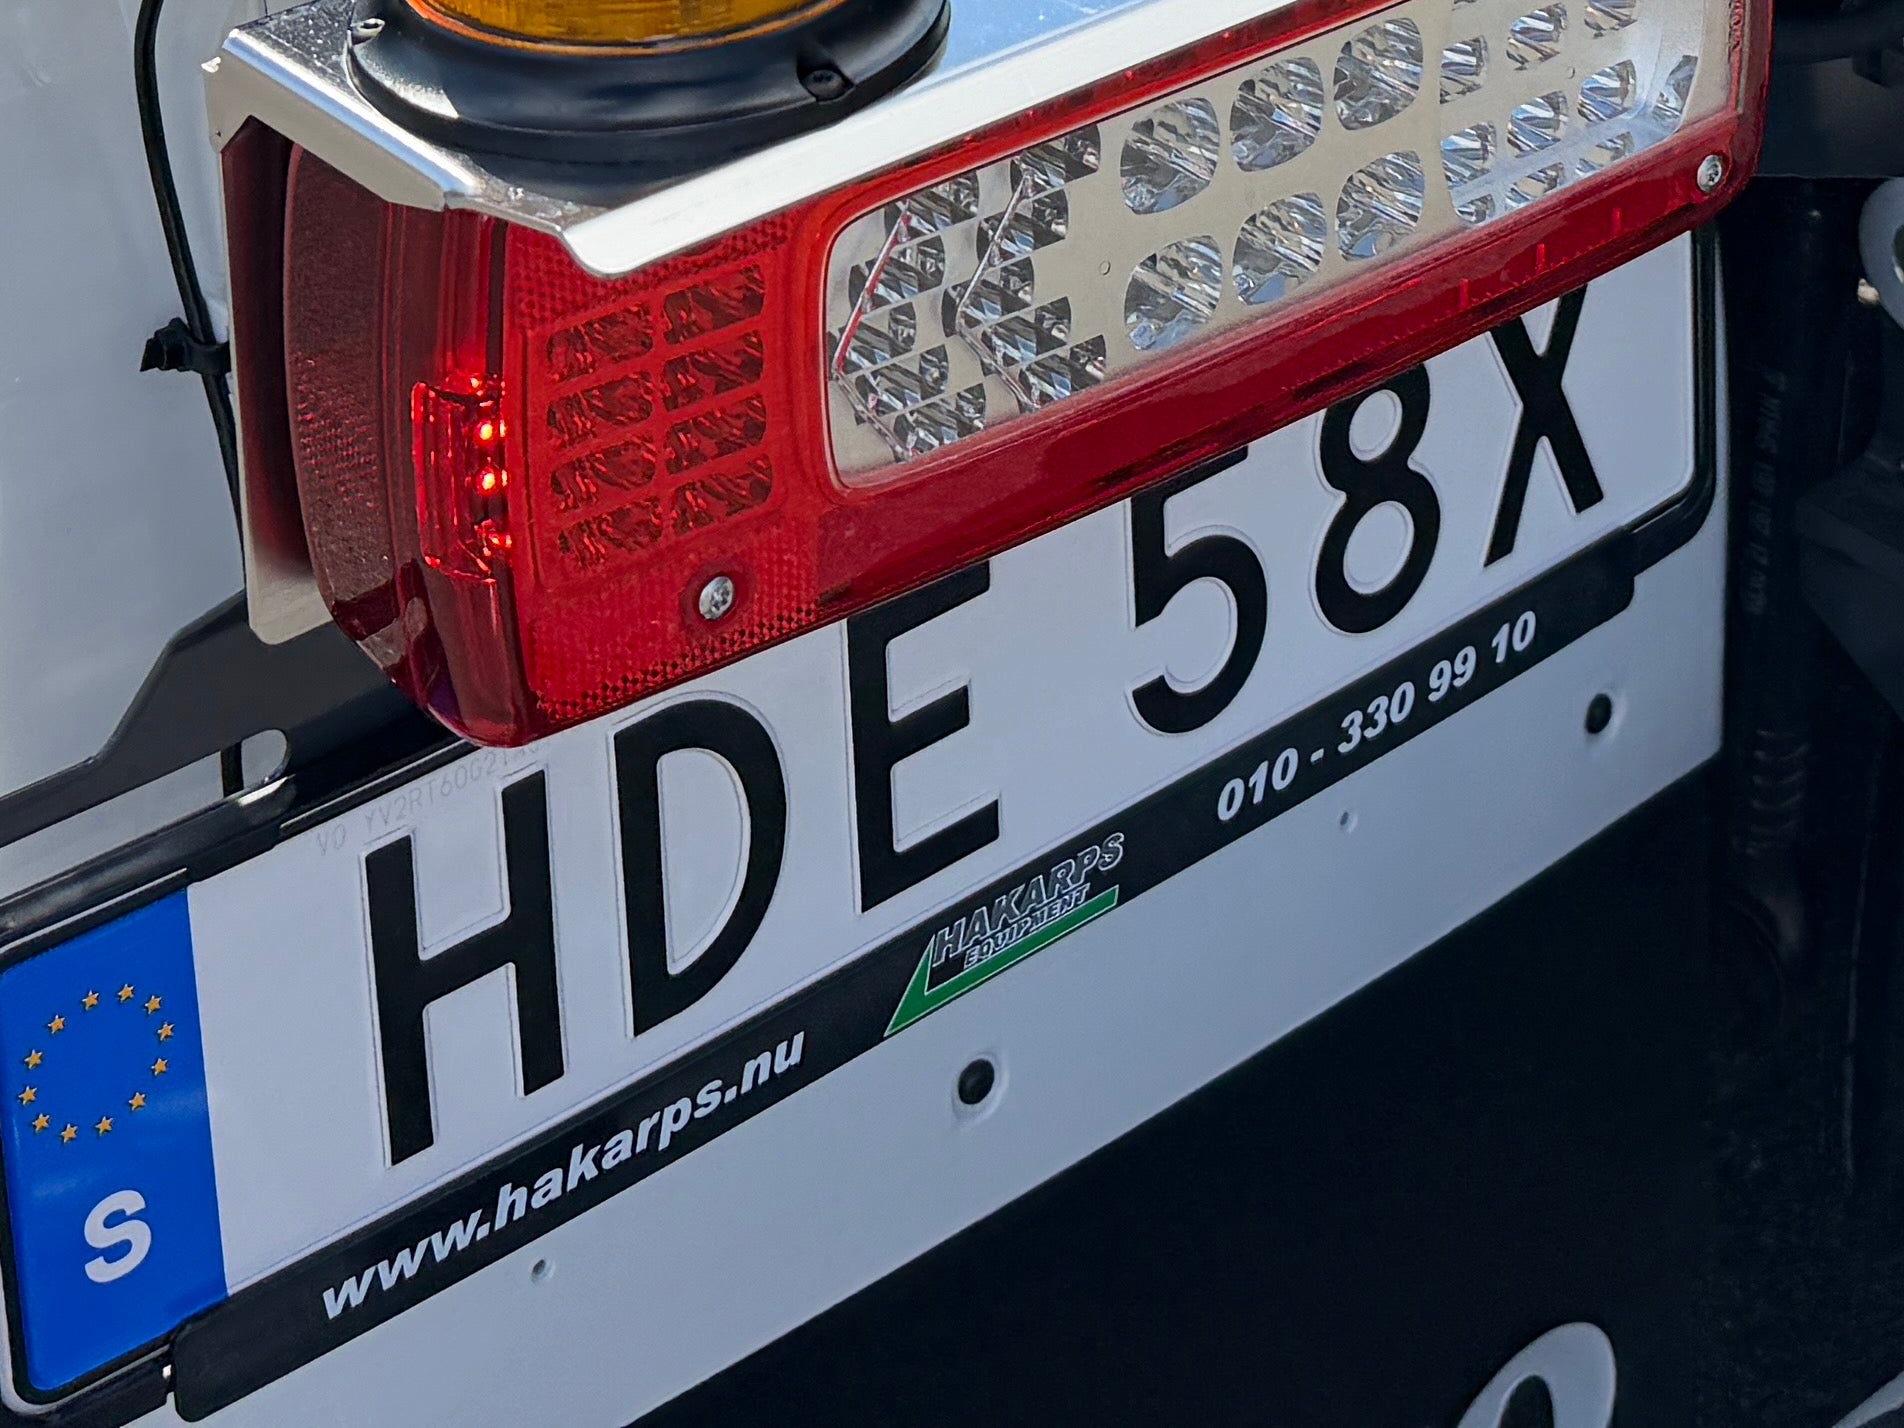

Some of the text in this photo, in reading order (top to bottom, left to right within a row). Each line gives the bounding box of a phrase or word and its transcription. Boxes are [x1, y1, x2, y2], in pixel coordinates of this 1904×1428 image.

[362, 560, 1002, 1170] HDE
[1127, 287, 1606, 734] 58X
[1217, 750, 1299, 823] 010
[1339, 682, 1414, 754] 330
[1427, 647, 1476, 703] 99
[1491, 610, 1538, 665] 10
[933, 832, 1126, 967] HAKARPS
[963, 886, 1093, 970] EQUIPMENT
[84, 1190, 153, 1284] S
[321, 1030, 805, 1320] www.hakarps.nu
